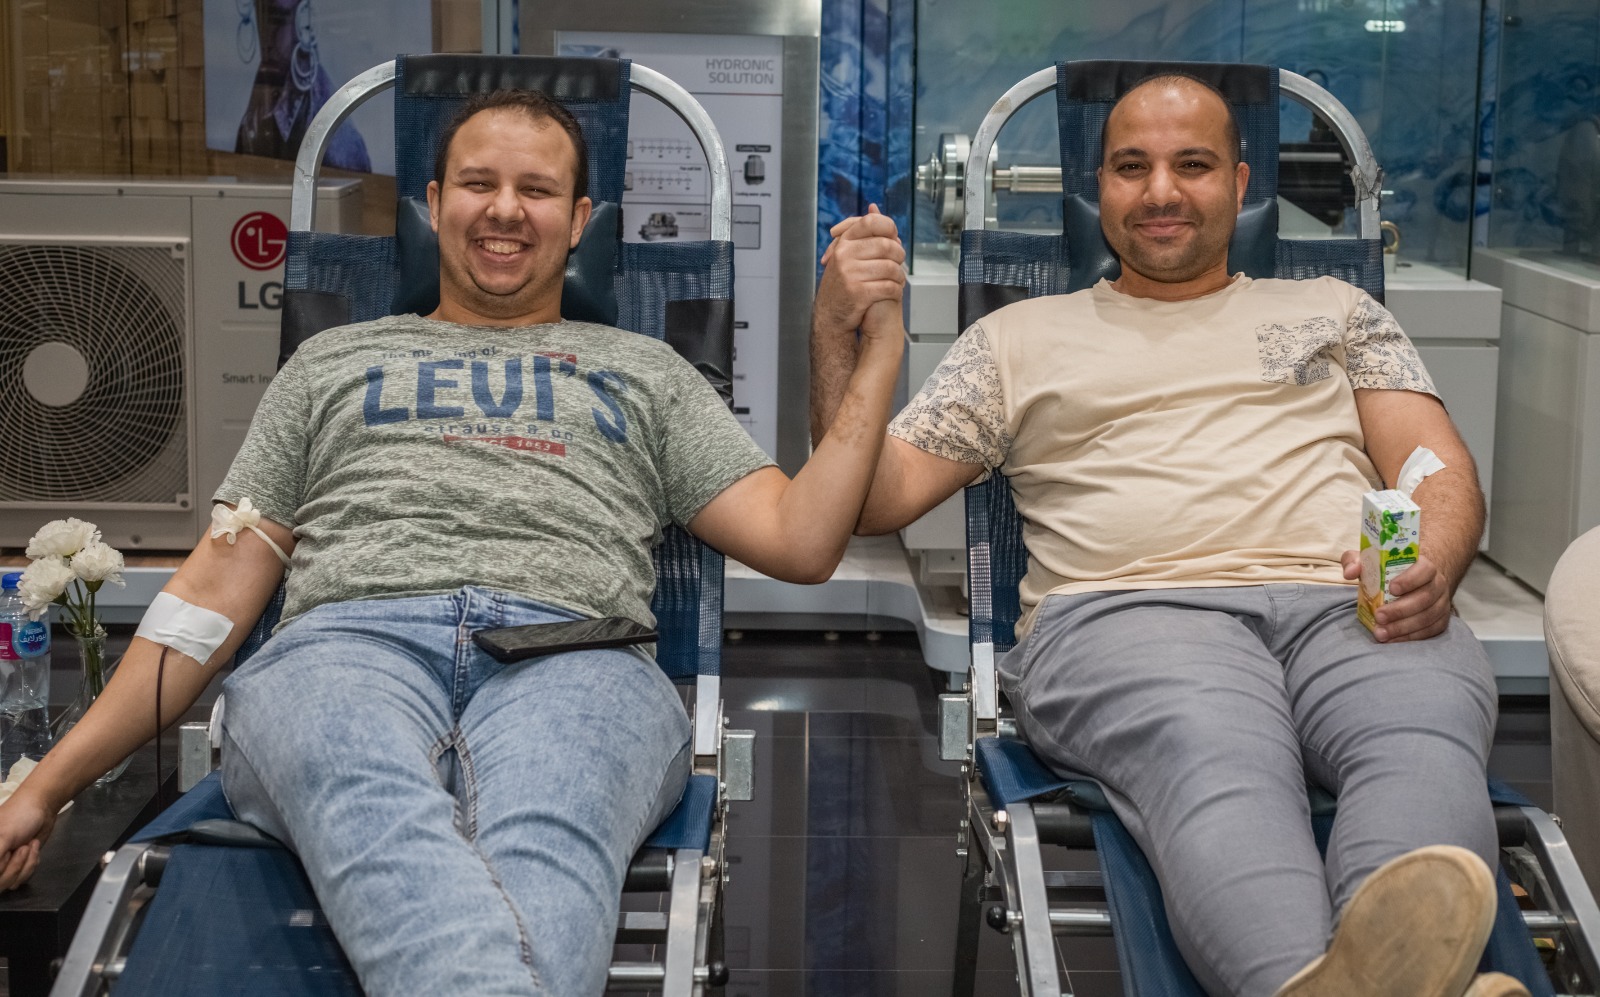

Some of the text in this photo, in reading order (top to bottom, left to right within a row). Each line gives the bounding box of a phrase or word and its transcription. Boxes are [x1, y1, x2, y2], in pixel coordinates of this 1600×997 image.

[706, 58, 775, 71] HYDRONIC
[708, 72, 774, 84] SOLUTION
[238, 281, 284, 310] LG
[222, 373, 254, 383] Smart
[363, 355, 628, 444] LEVI'S
